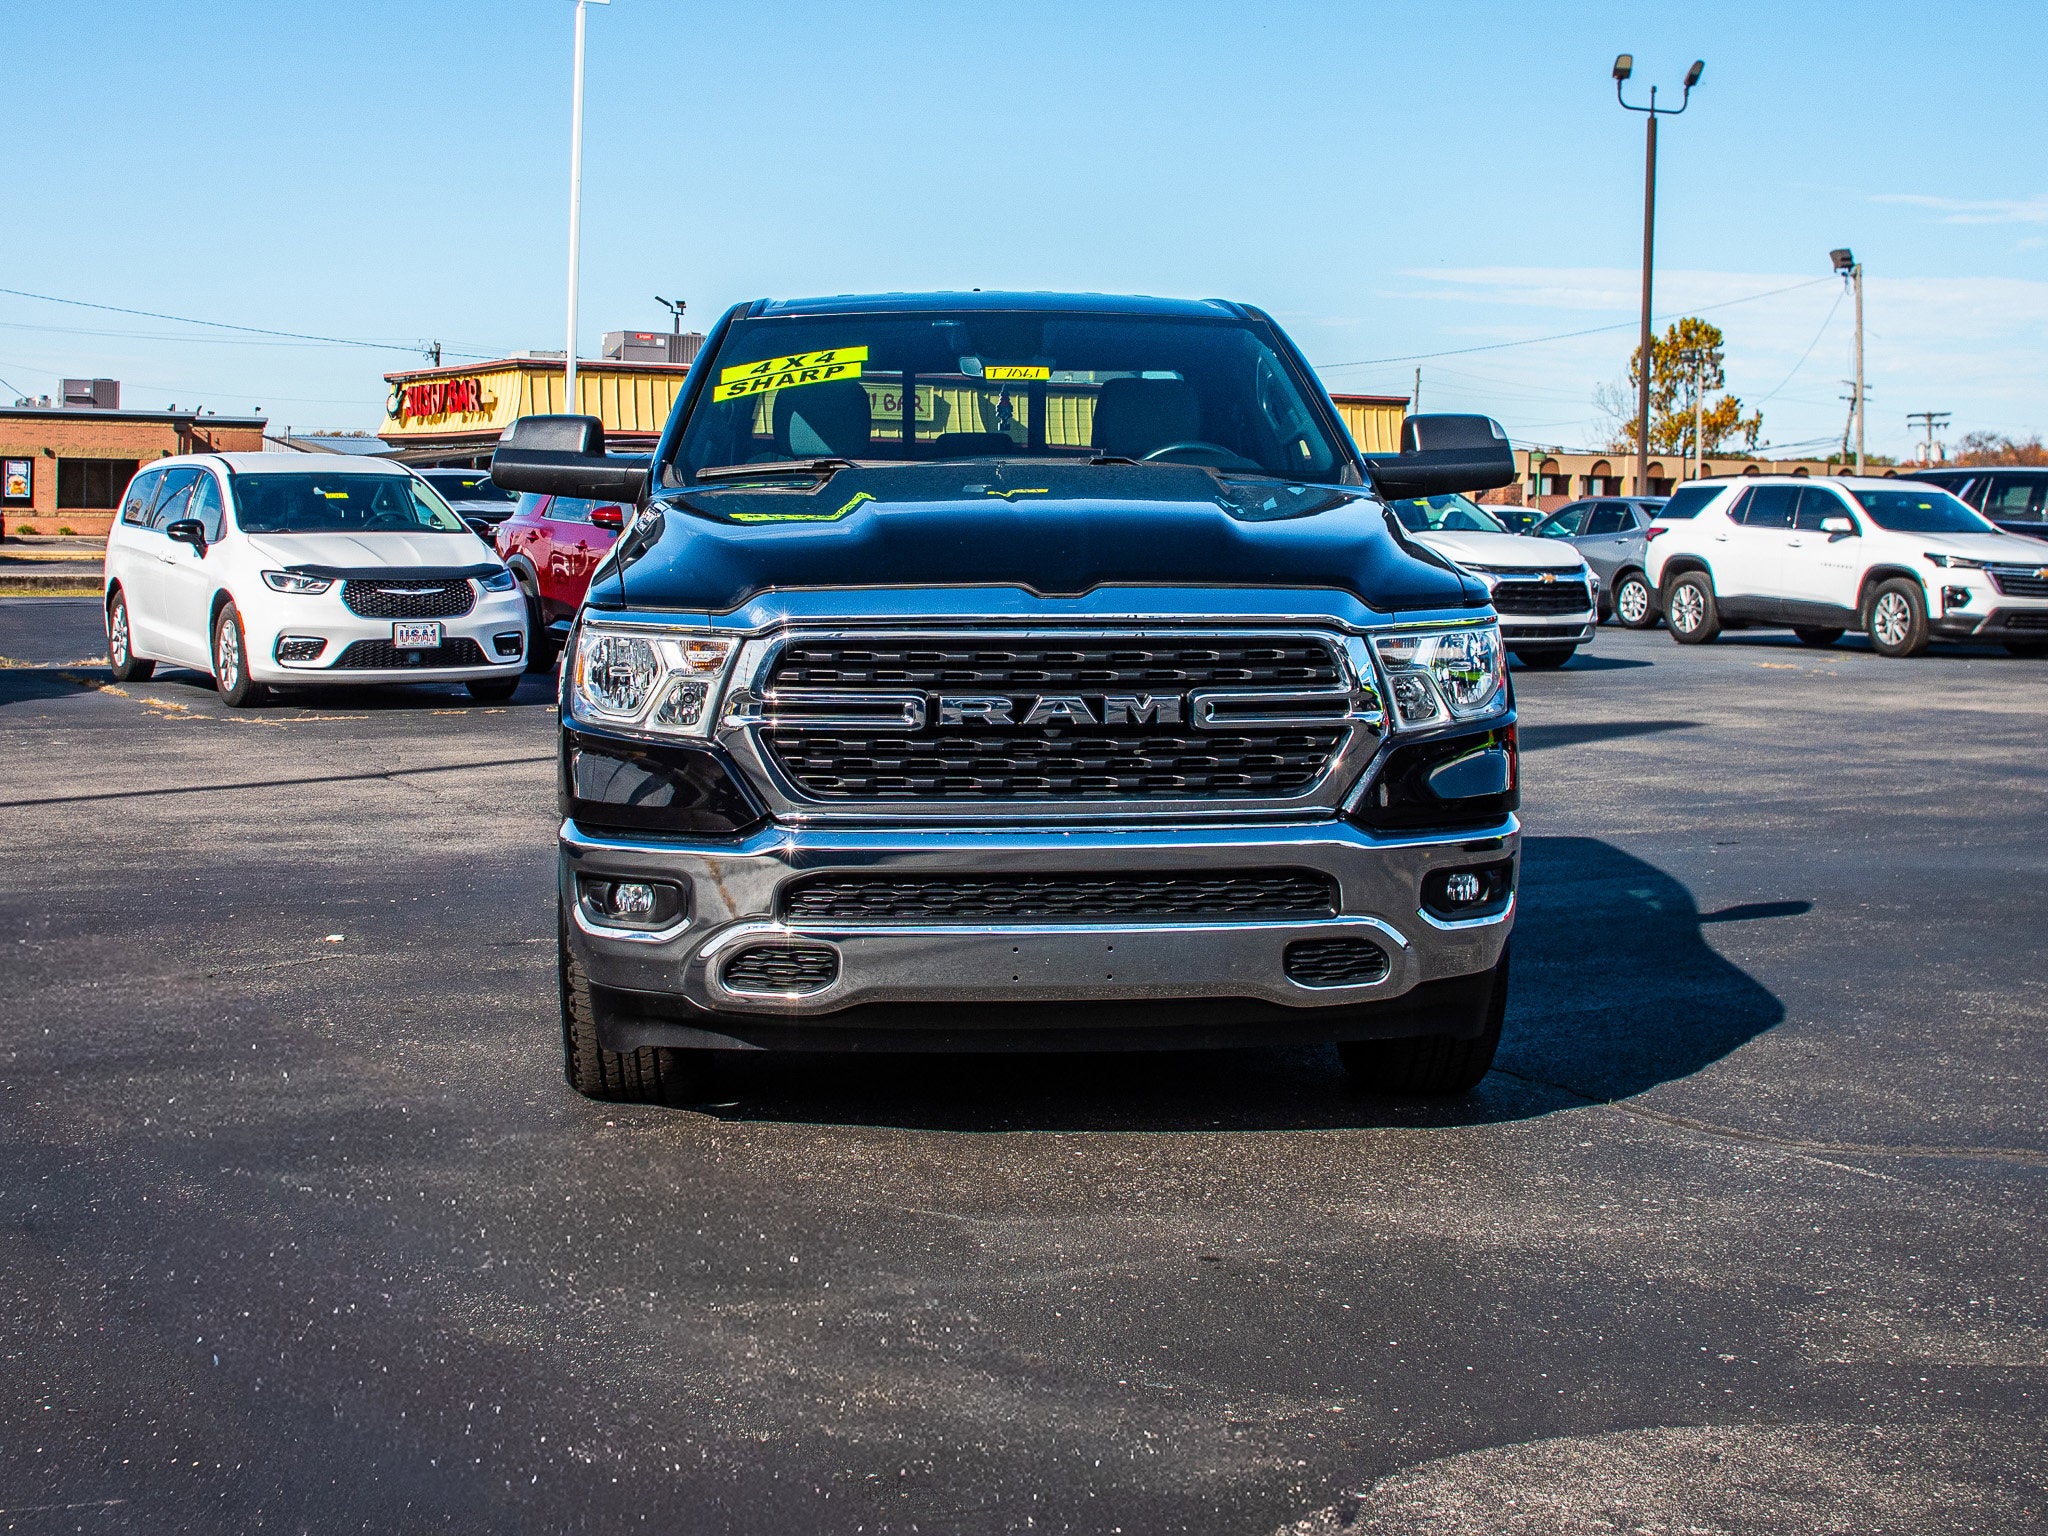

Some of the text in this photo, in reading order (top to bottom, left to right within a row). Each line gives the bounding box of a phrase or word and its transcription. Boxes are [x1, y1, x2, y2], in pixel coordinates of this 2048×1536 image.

[727, 365, 845, 397] SHARP
[405, 378, 481, 417] SUSHI BAR
[939, 694, 1182, 725] RAM
